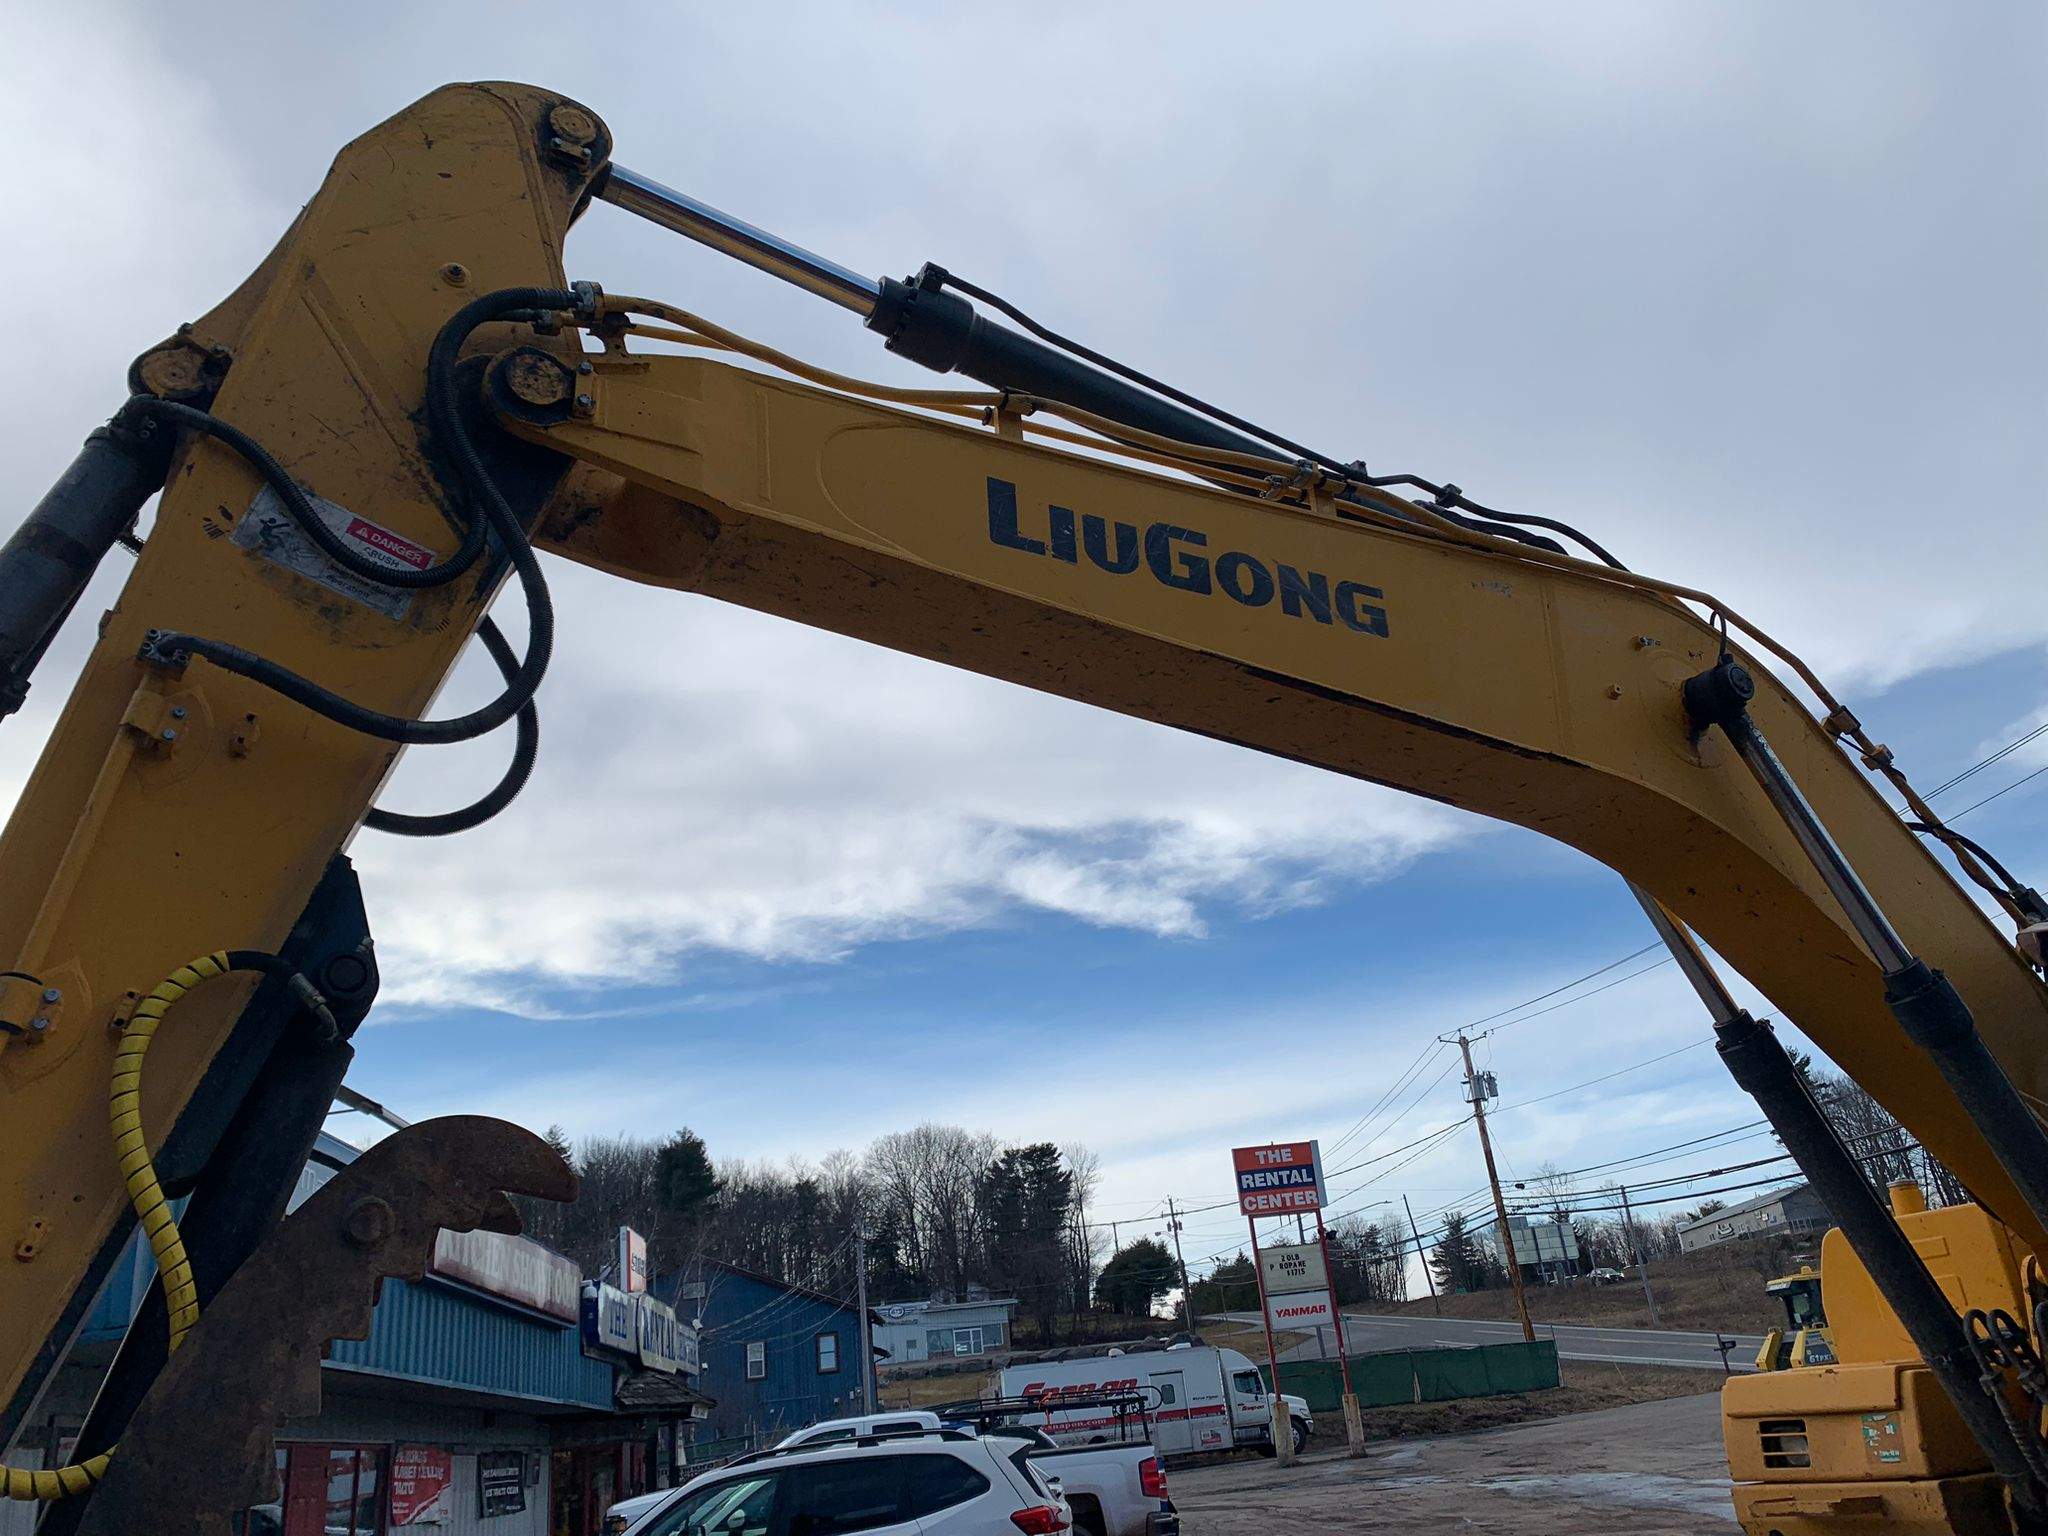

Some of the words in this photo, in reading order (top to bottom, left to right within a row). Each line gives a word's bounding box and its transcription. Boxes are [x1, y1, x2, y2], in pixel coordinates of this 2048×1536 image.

[364, 546, 400, 568] CRUSH
[370, 531, 423, 564] DANGER
[1255, 1148, 1293, 1164] THE
[1241, 1168, 1313, 1189] RENTAL
[1243, 1190, 1319, 1211] CENTER
[1275, 1304, 1327, 1318] YANMAR
